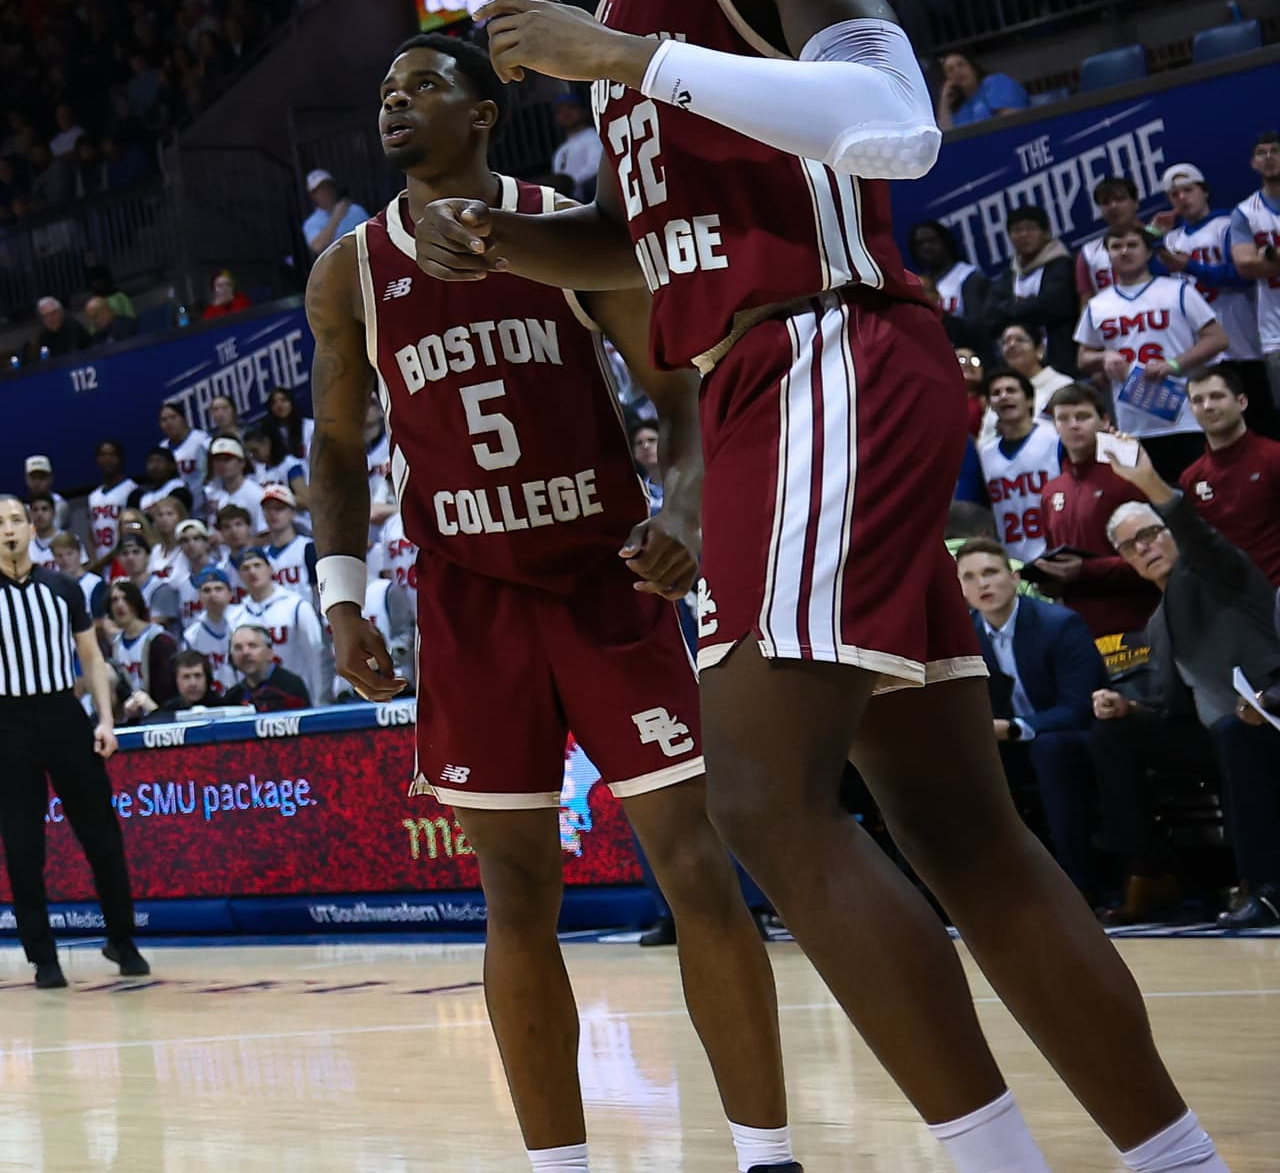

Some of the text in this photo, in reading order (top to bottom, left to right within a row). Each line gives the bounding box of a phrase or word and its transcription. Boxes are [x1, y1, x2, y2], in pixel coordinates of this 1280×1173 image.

[607, 98, 668, 222] 22
[1016, 135, 1055, 174] THE
[1100, 309, 1170, 341] SMU
[216, 336, 239, 364] THE
[395, 319, 563, 395] BOSTON
[70, 366, 98, 392] 112
[458, 379, 521, 471] 5
[432, 469, 604, 537] COLLEGE
[987, 471, 1048, 500] SMU
[1003, 509, 1042, 544] 26
[143, 727, 186, 748] UTSW
[255, 716, 301, 738] UTSW
[139, 780, 196, 817] SMU
[203, 775, 318, 823] package.
